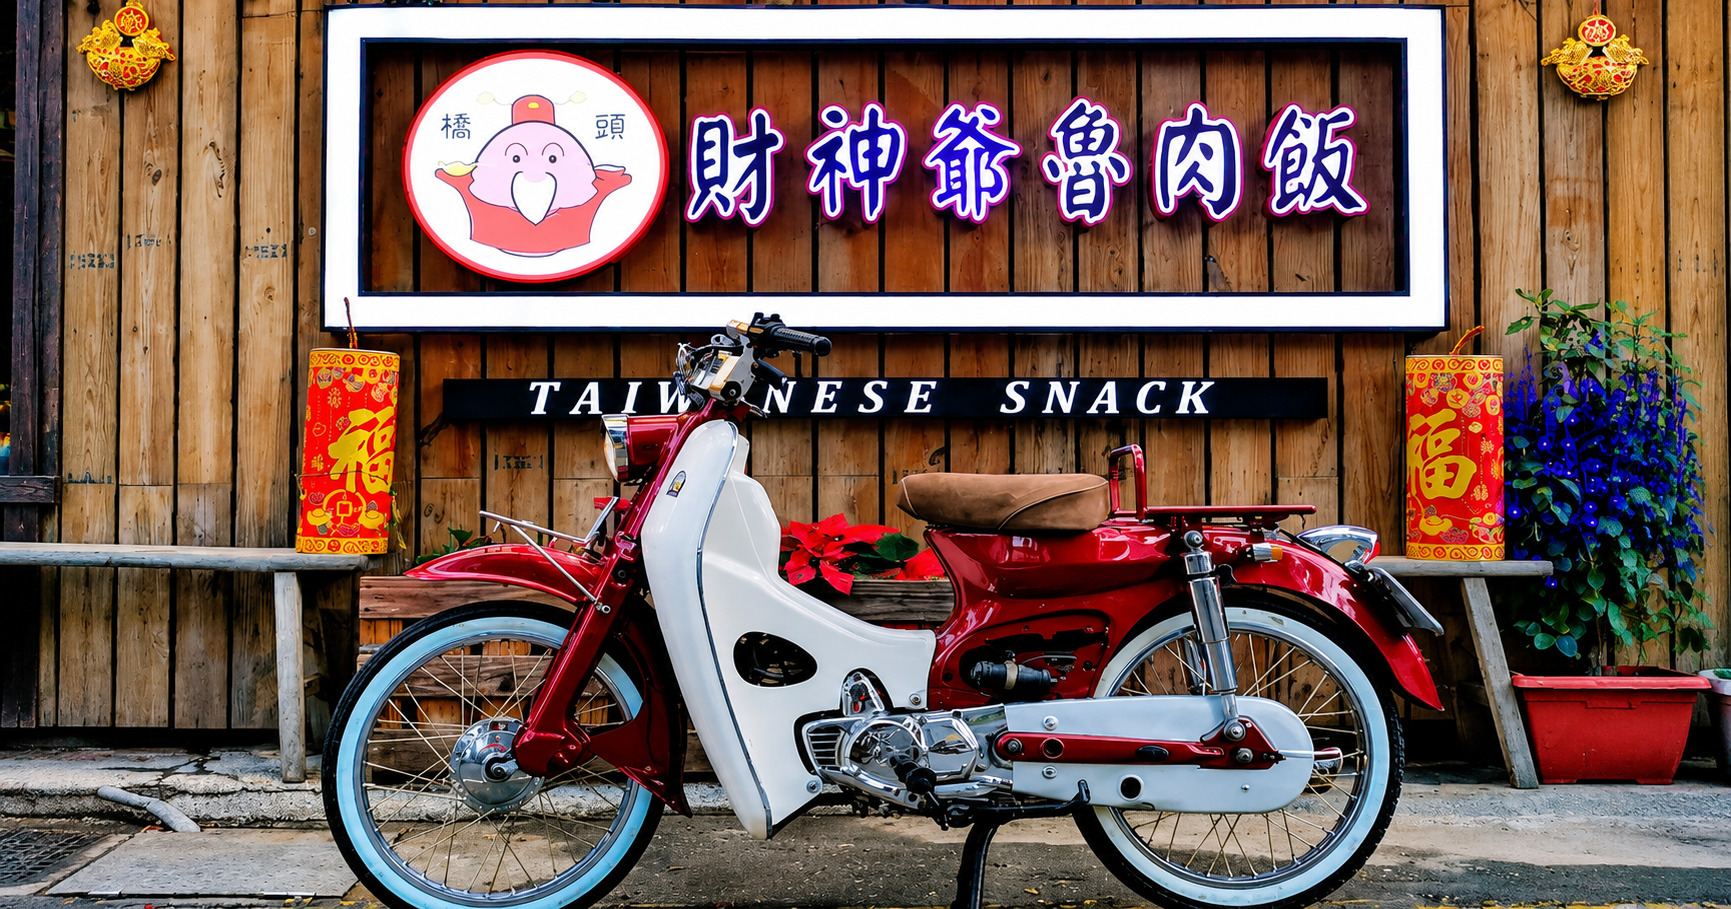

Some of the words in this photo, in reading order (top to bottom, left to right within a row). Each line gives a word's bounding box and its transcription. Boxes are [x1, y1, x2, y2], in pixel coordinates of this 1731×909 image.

[440, 113, 471, 140] 橋
[595, 113, 626, 140] 頭
[687, 97, 1370, 225] 財神爺魯肉飯
[529, 380, 938, 415] TAIWNESE
[999, 380, 1216, 415] SNACK
[328, 406, 395, 494] 福
[1406, 408, 1477, 500] 福
